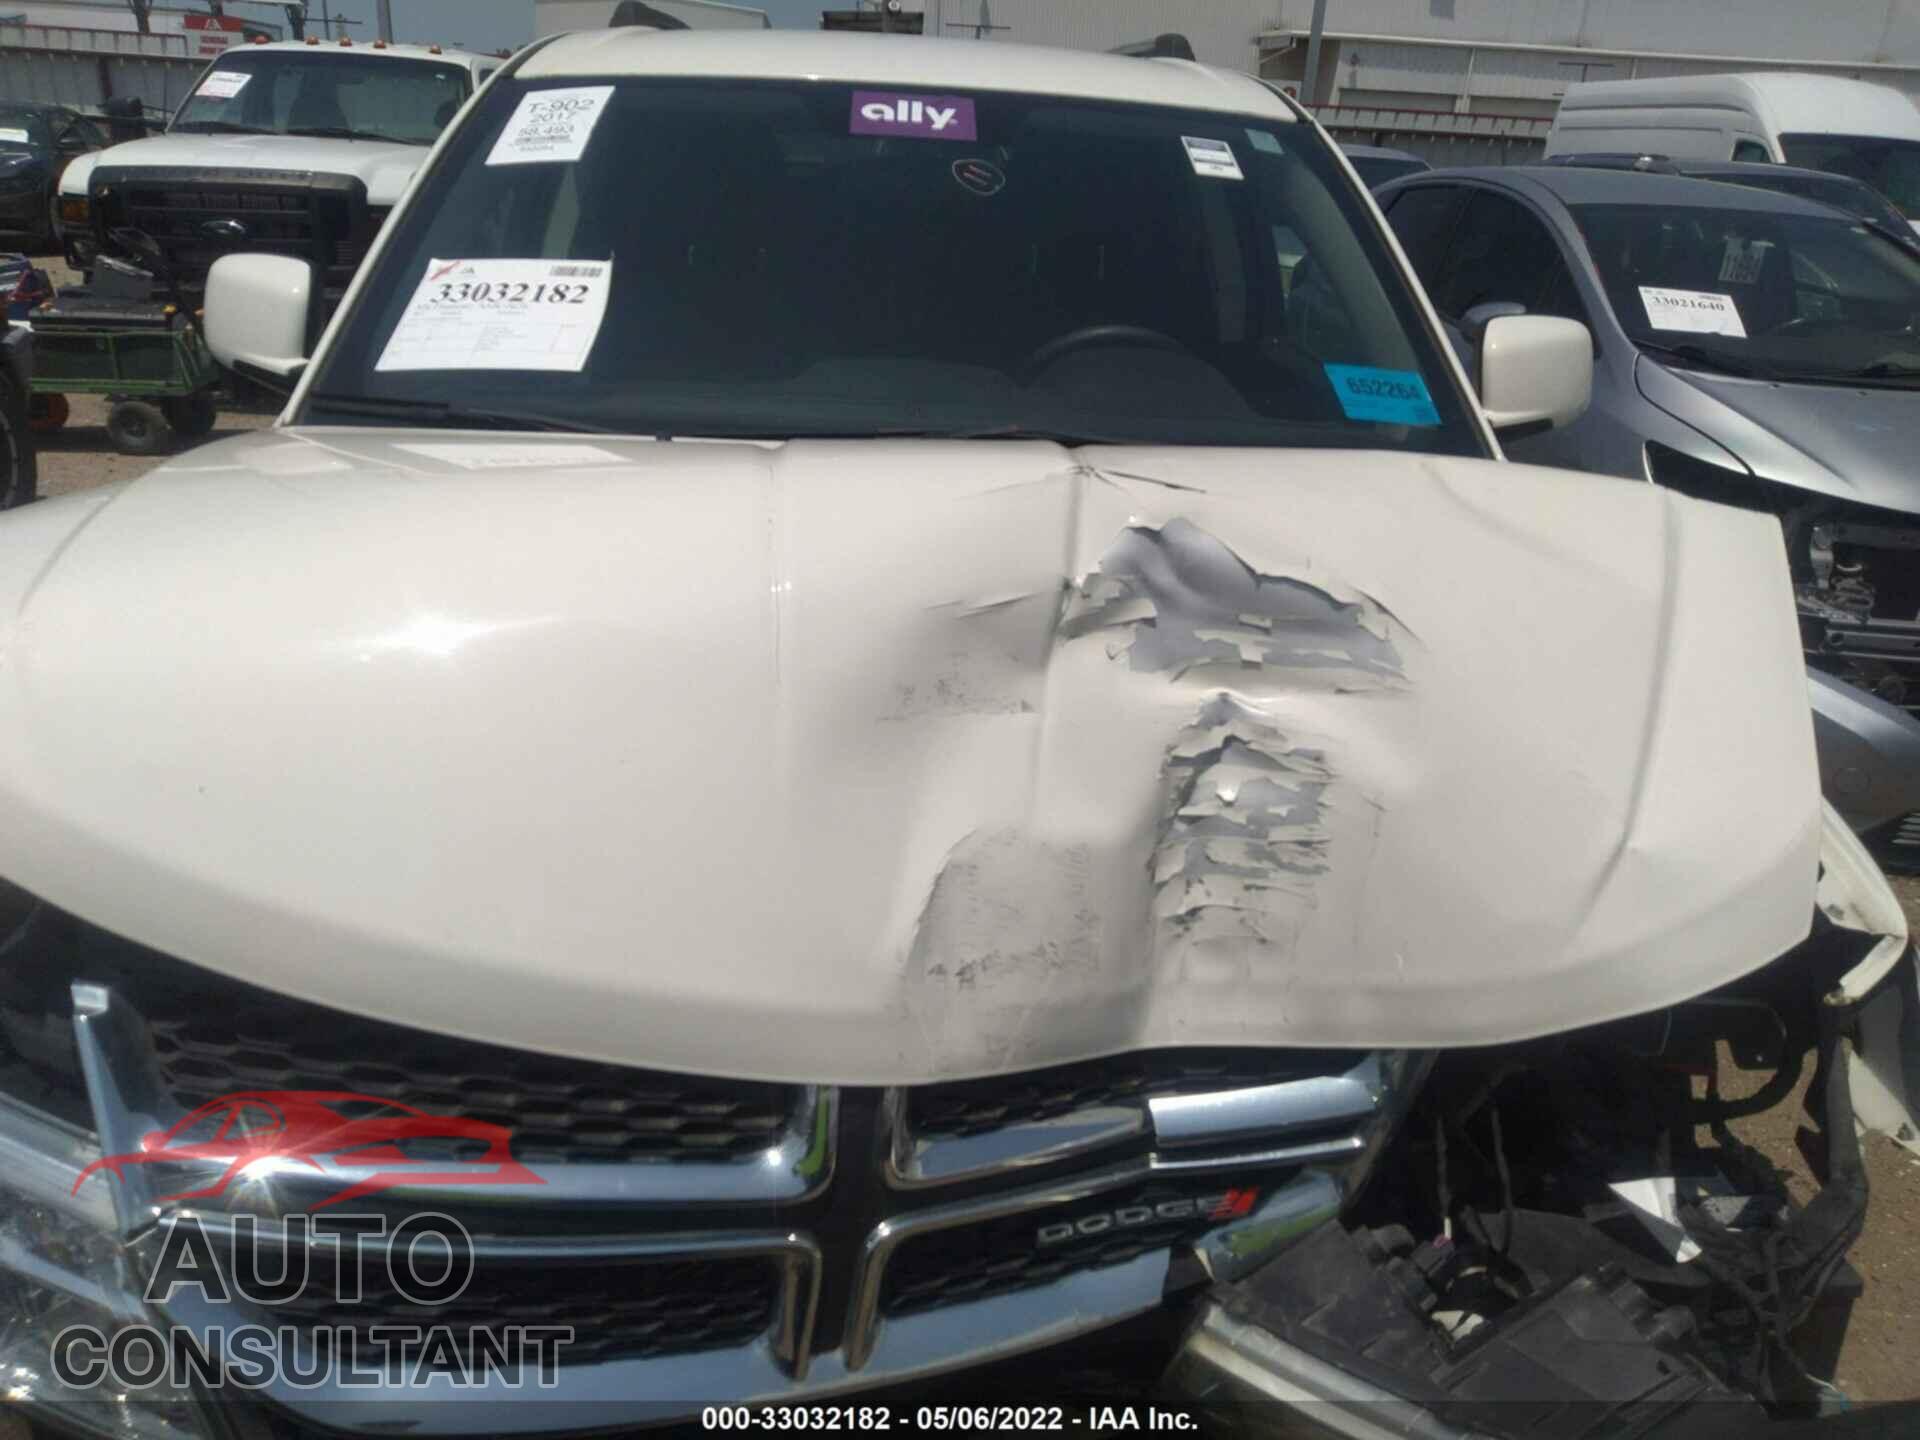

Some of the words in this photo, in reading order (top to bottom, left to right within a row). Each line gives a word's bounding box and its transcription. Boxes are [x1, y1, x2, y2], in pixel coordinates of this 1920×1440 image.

[860, 99, 957, 130] ally
[430, 281, 590, 304] 33032182
[1037, 1198, 1235, 1242] DODGE
